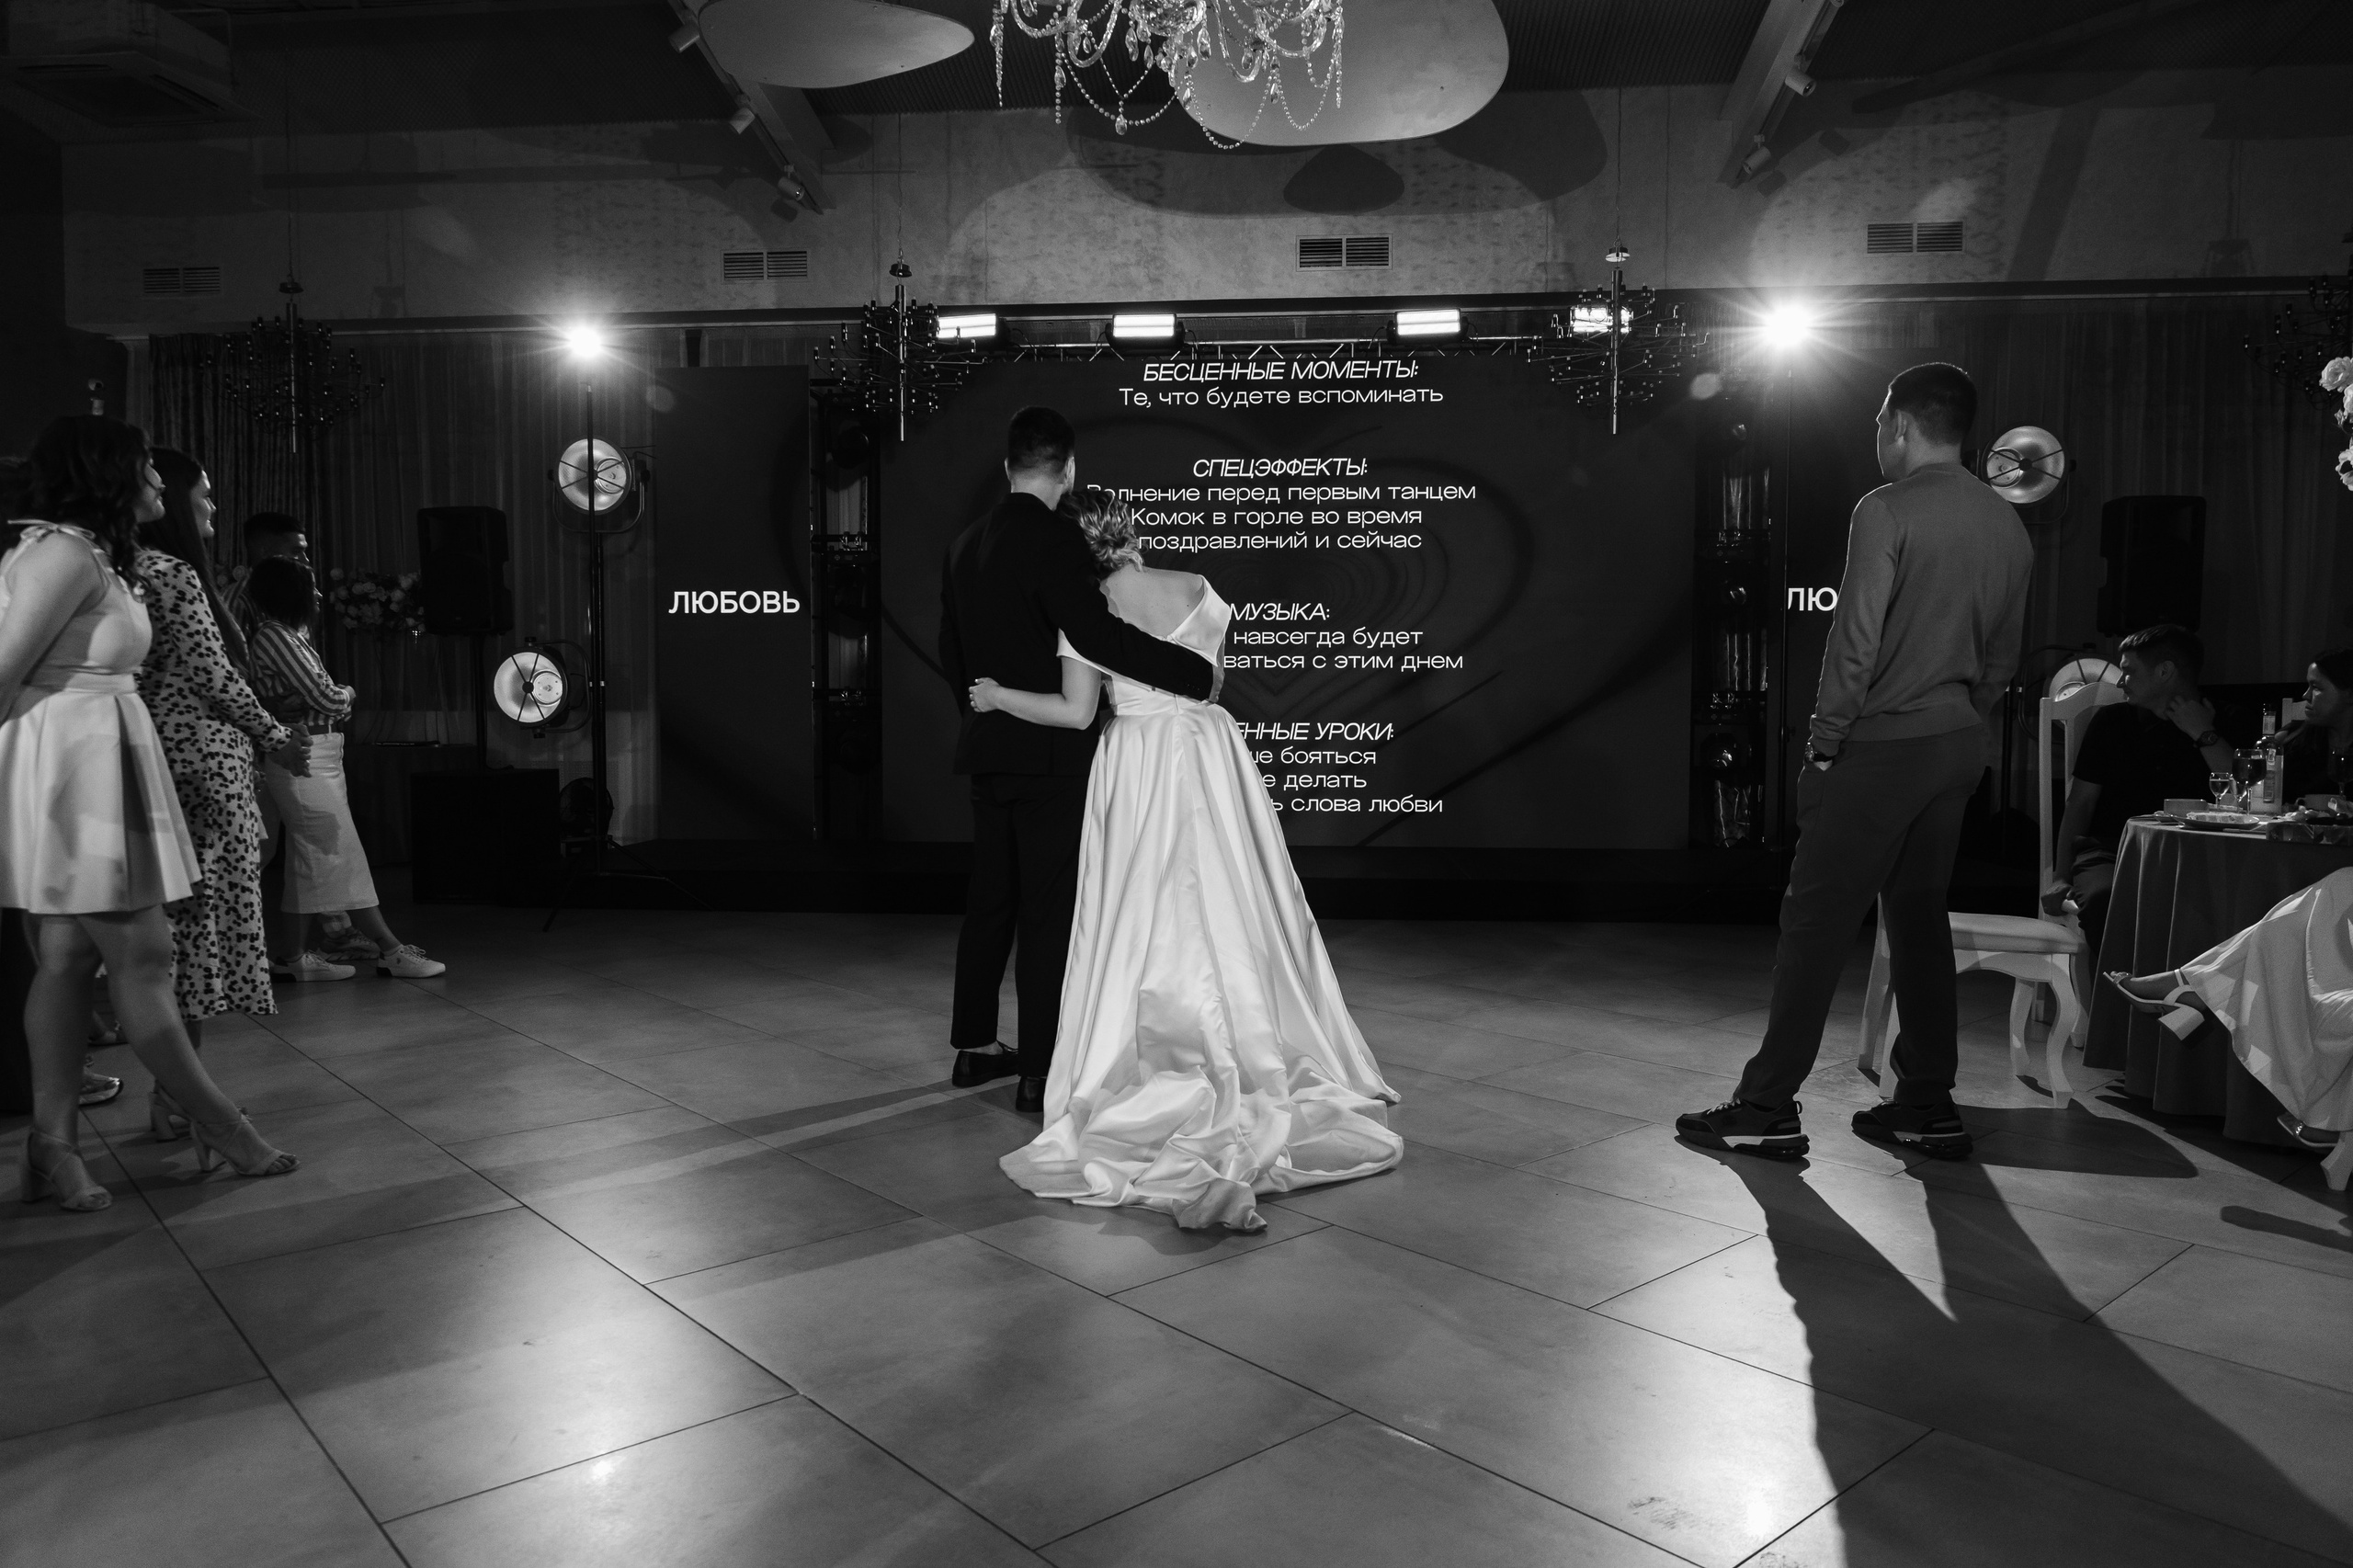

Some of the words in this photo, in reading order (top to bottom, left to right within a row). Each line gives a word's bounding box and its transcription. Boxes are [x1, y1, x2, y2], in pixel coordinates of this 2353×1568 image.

[1142, 361, 1287, 383] БЕСЦЕННЫЕ
[1290, 359, 1419, 380] МОМЕНТЫ:
[1119, 388, 1152, 409] Те,
[1159, 392, 1199, 405] что
[1206, 386, 1290, 409] будете
[1298, 389, 1444, 404] вспоминать
[1192, 458, 1369, 479] СПЕЦЭФФЕКТЫ:
[1208, 487, 1280, 506] перед
[1288, 487, 1381, 506] первым
[1387, 485, 1476, 502] танцем
[1131, 508, 1205, 526] Комок
[1212, 512, 1227, 525] в
[1233, 511, 1304, 529] горле
[1311, 511, 1340, 525] во
[1347, 510, 1422, 529] время
[1139, 530, 1308, 554] поздравлений
[1315, 535, 1329, 549] и
[1336, 530, 1422, 549] сейчас
[667, 590, 801, 614] ЛЮБОВЬ
[1229, 602, 1330, 621] МУЗЫКА:
[1233, 631, 1346, 649] навсегда
[1352, 626, 1424, 649] будет
[1312, 654, 1327, 669] с
[1334, 654, 1393, 669] этим
[1401, 654, 1463, 673] днем
[1314, 722, 1394, 741] УРОКИ:
[1280, 745, 1377, 765] бояться
[1283, 774, 1368, 791] делать
[1290, 798, 1361, 812] слова
[1368, 793, 1443, 812] любви
